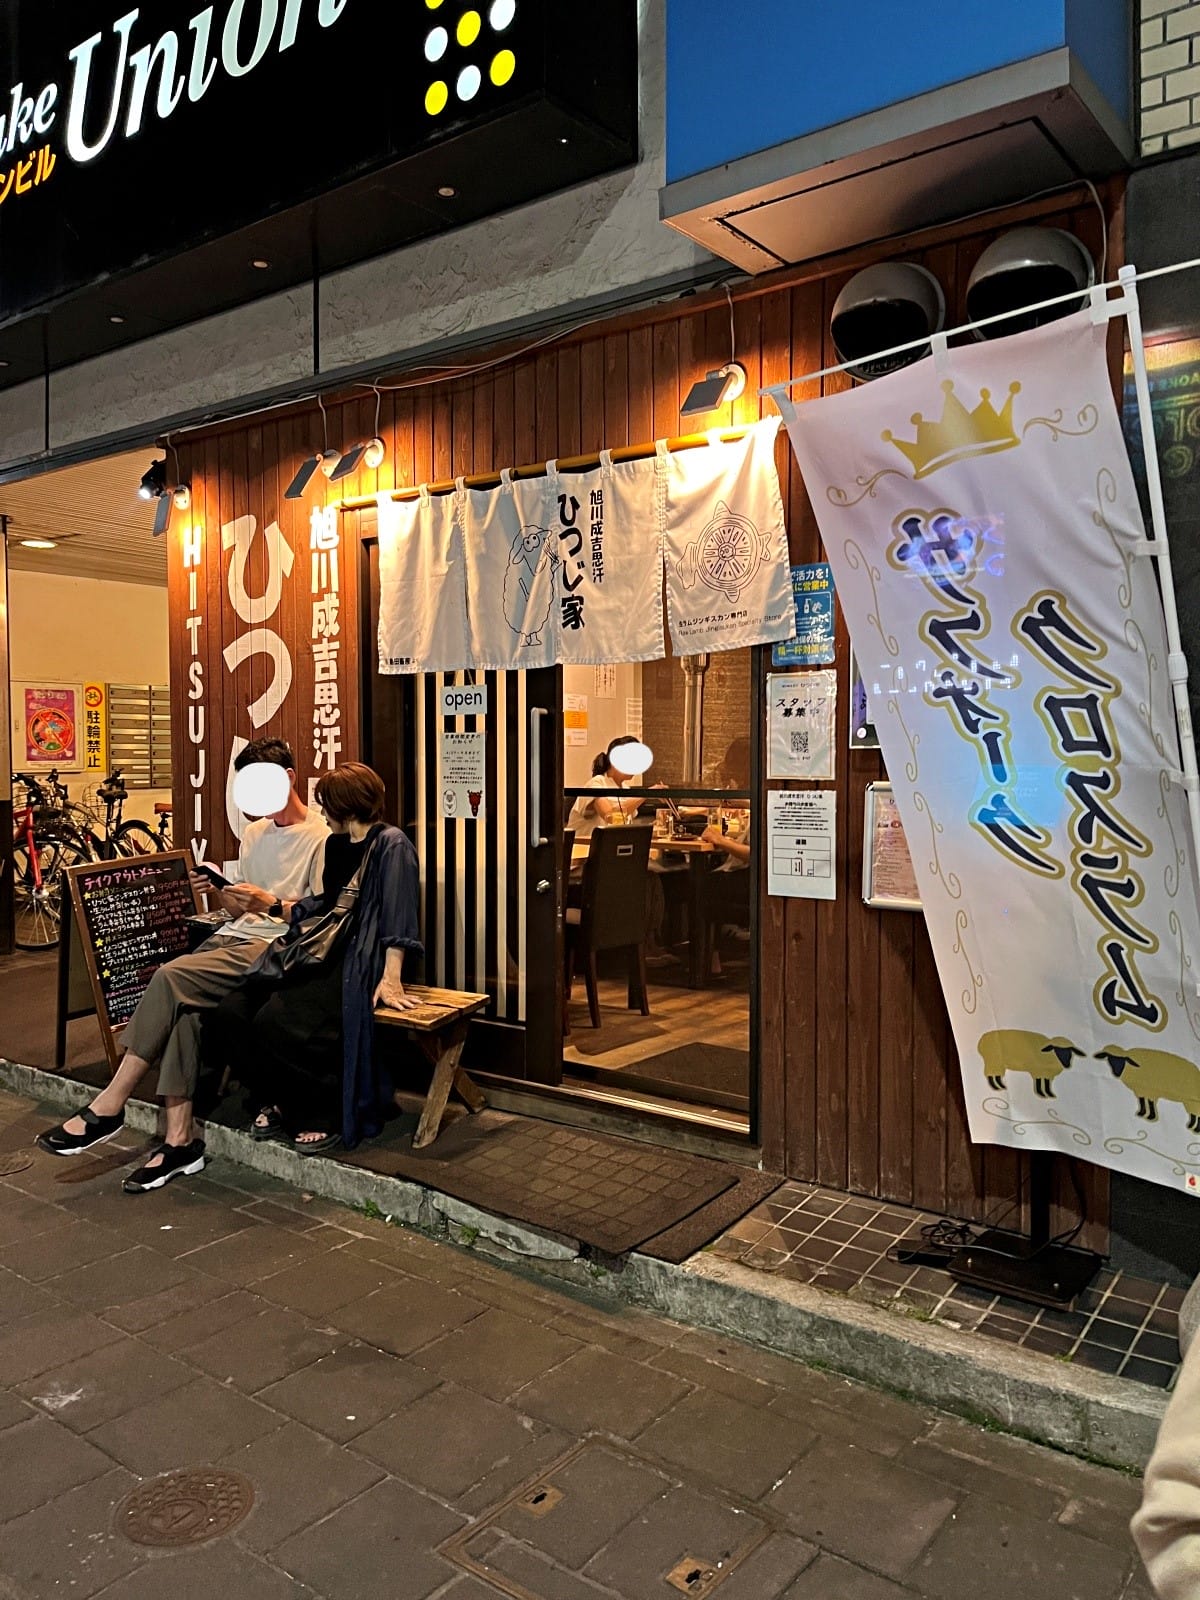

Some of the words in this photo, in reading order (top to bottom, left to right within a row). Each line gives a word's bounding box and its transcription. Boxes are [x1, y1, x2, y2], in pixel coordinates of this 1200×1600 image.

[590, 489, 604, 583] 旭川成吉思汗
[557, 493, 585, 630] ひつじ家
[309, 505, 342, 770] 旭川成吉思汗
[445, 692, 482, 711] open
[776, 698, 826, 708] スタッフ
[783, 707, 820, 718] 募集中
[87, 710, 101, 768] 駐輪禁止
[84, 867, 172, 890] テイクアウトメニュー
